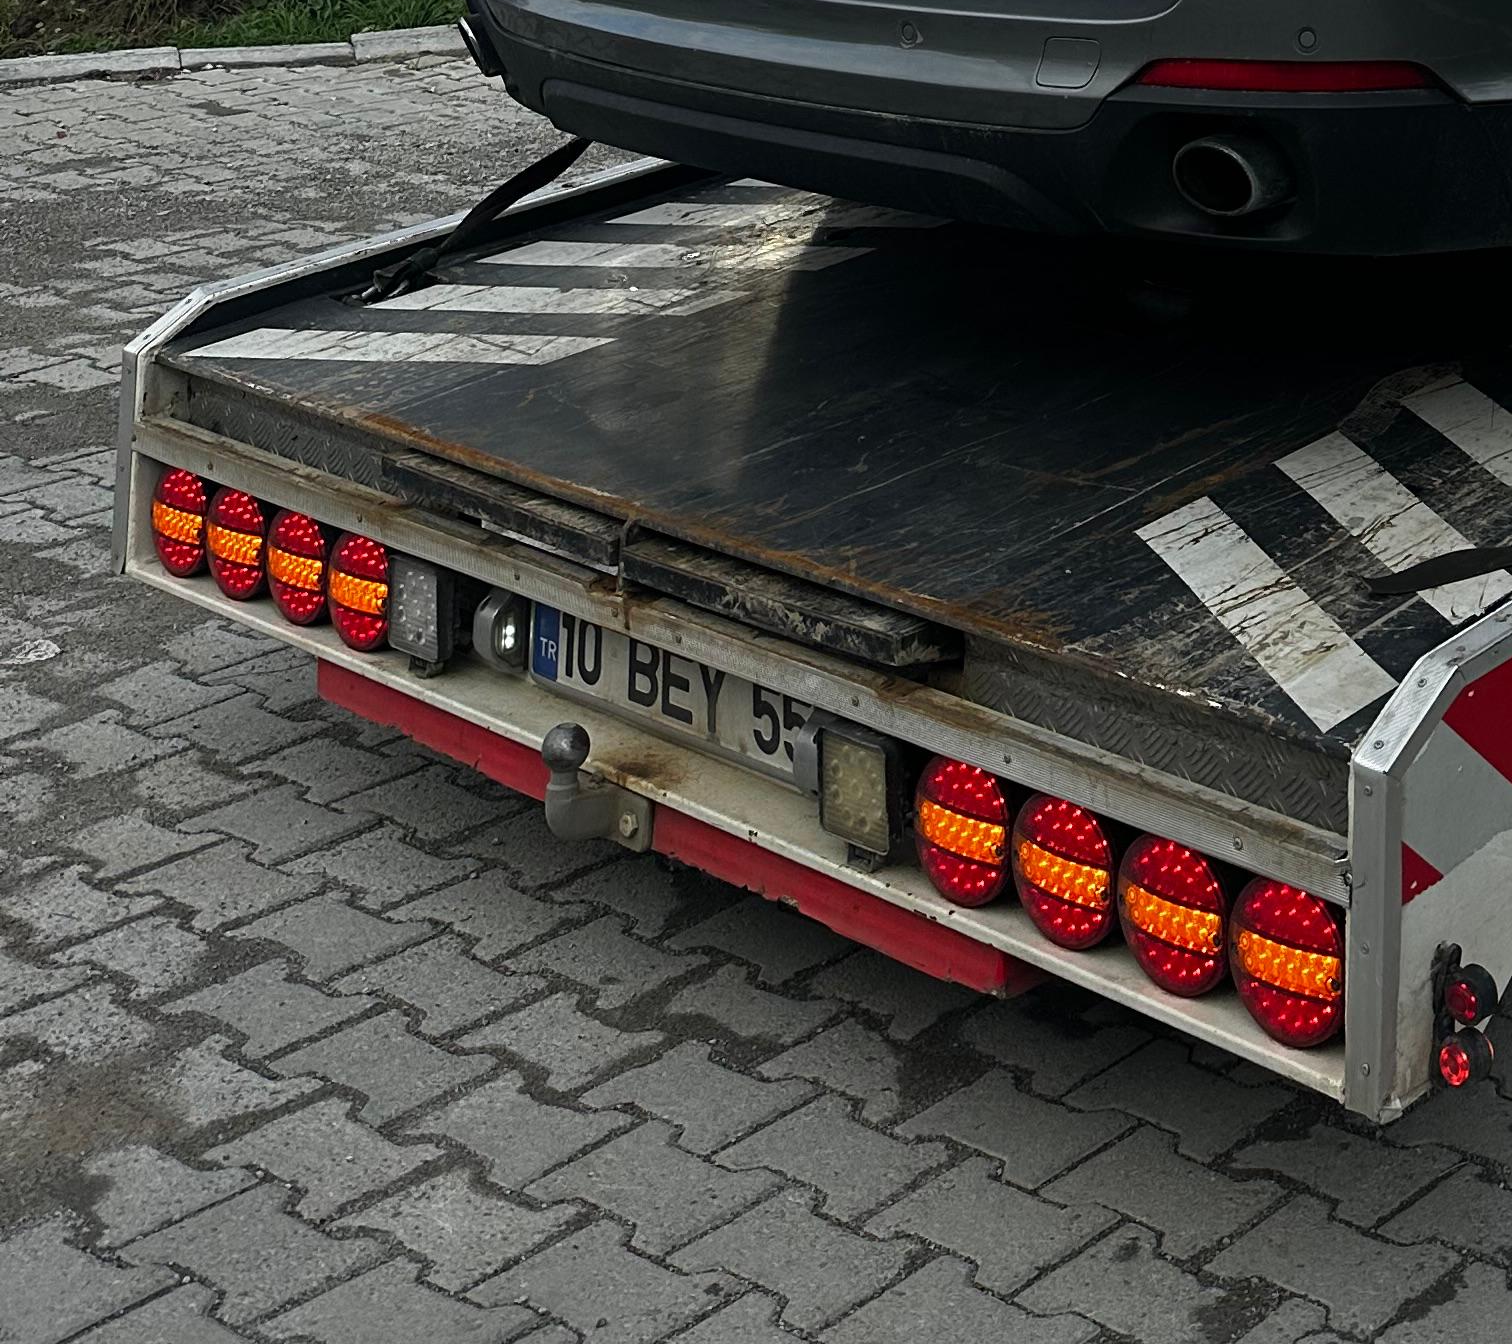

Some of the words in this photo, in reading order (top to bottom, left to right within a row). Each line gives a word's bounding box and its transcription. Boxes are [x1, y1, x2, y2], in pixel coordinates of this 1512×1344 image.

[539, 636, 557, 662] TR
[562, 612, 603, 686] 10
[628, 637, 727, 734] BEY
